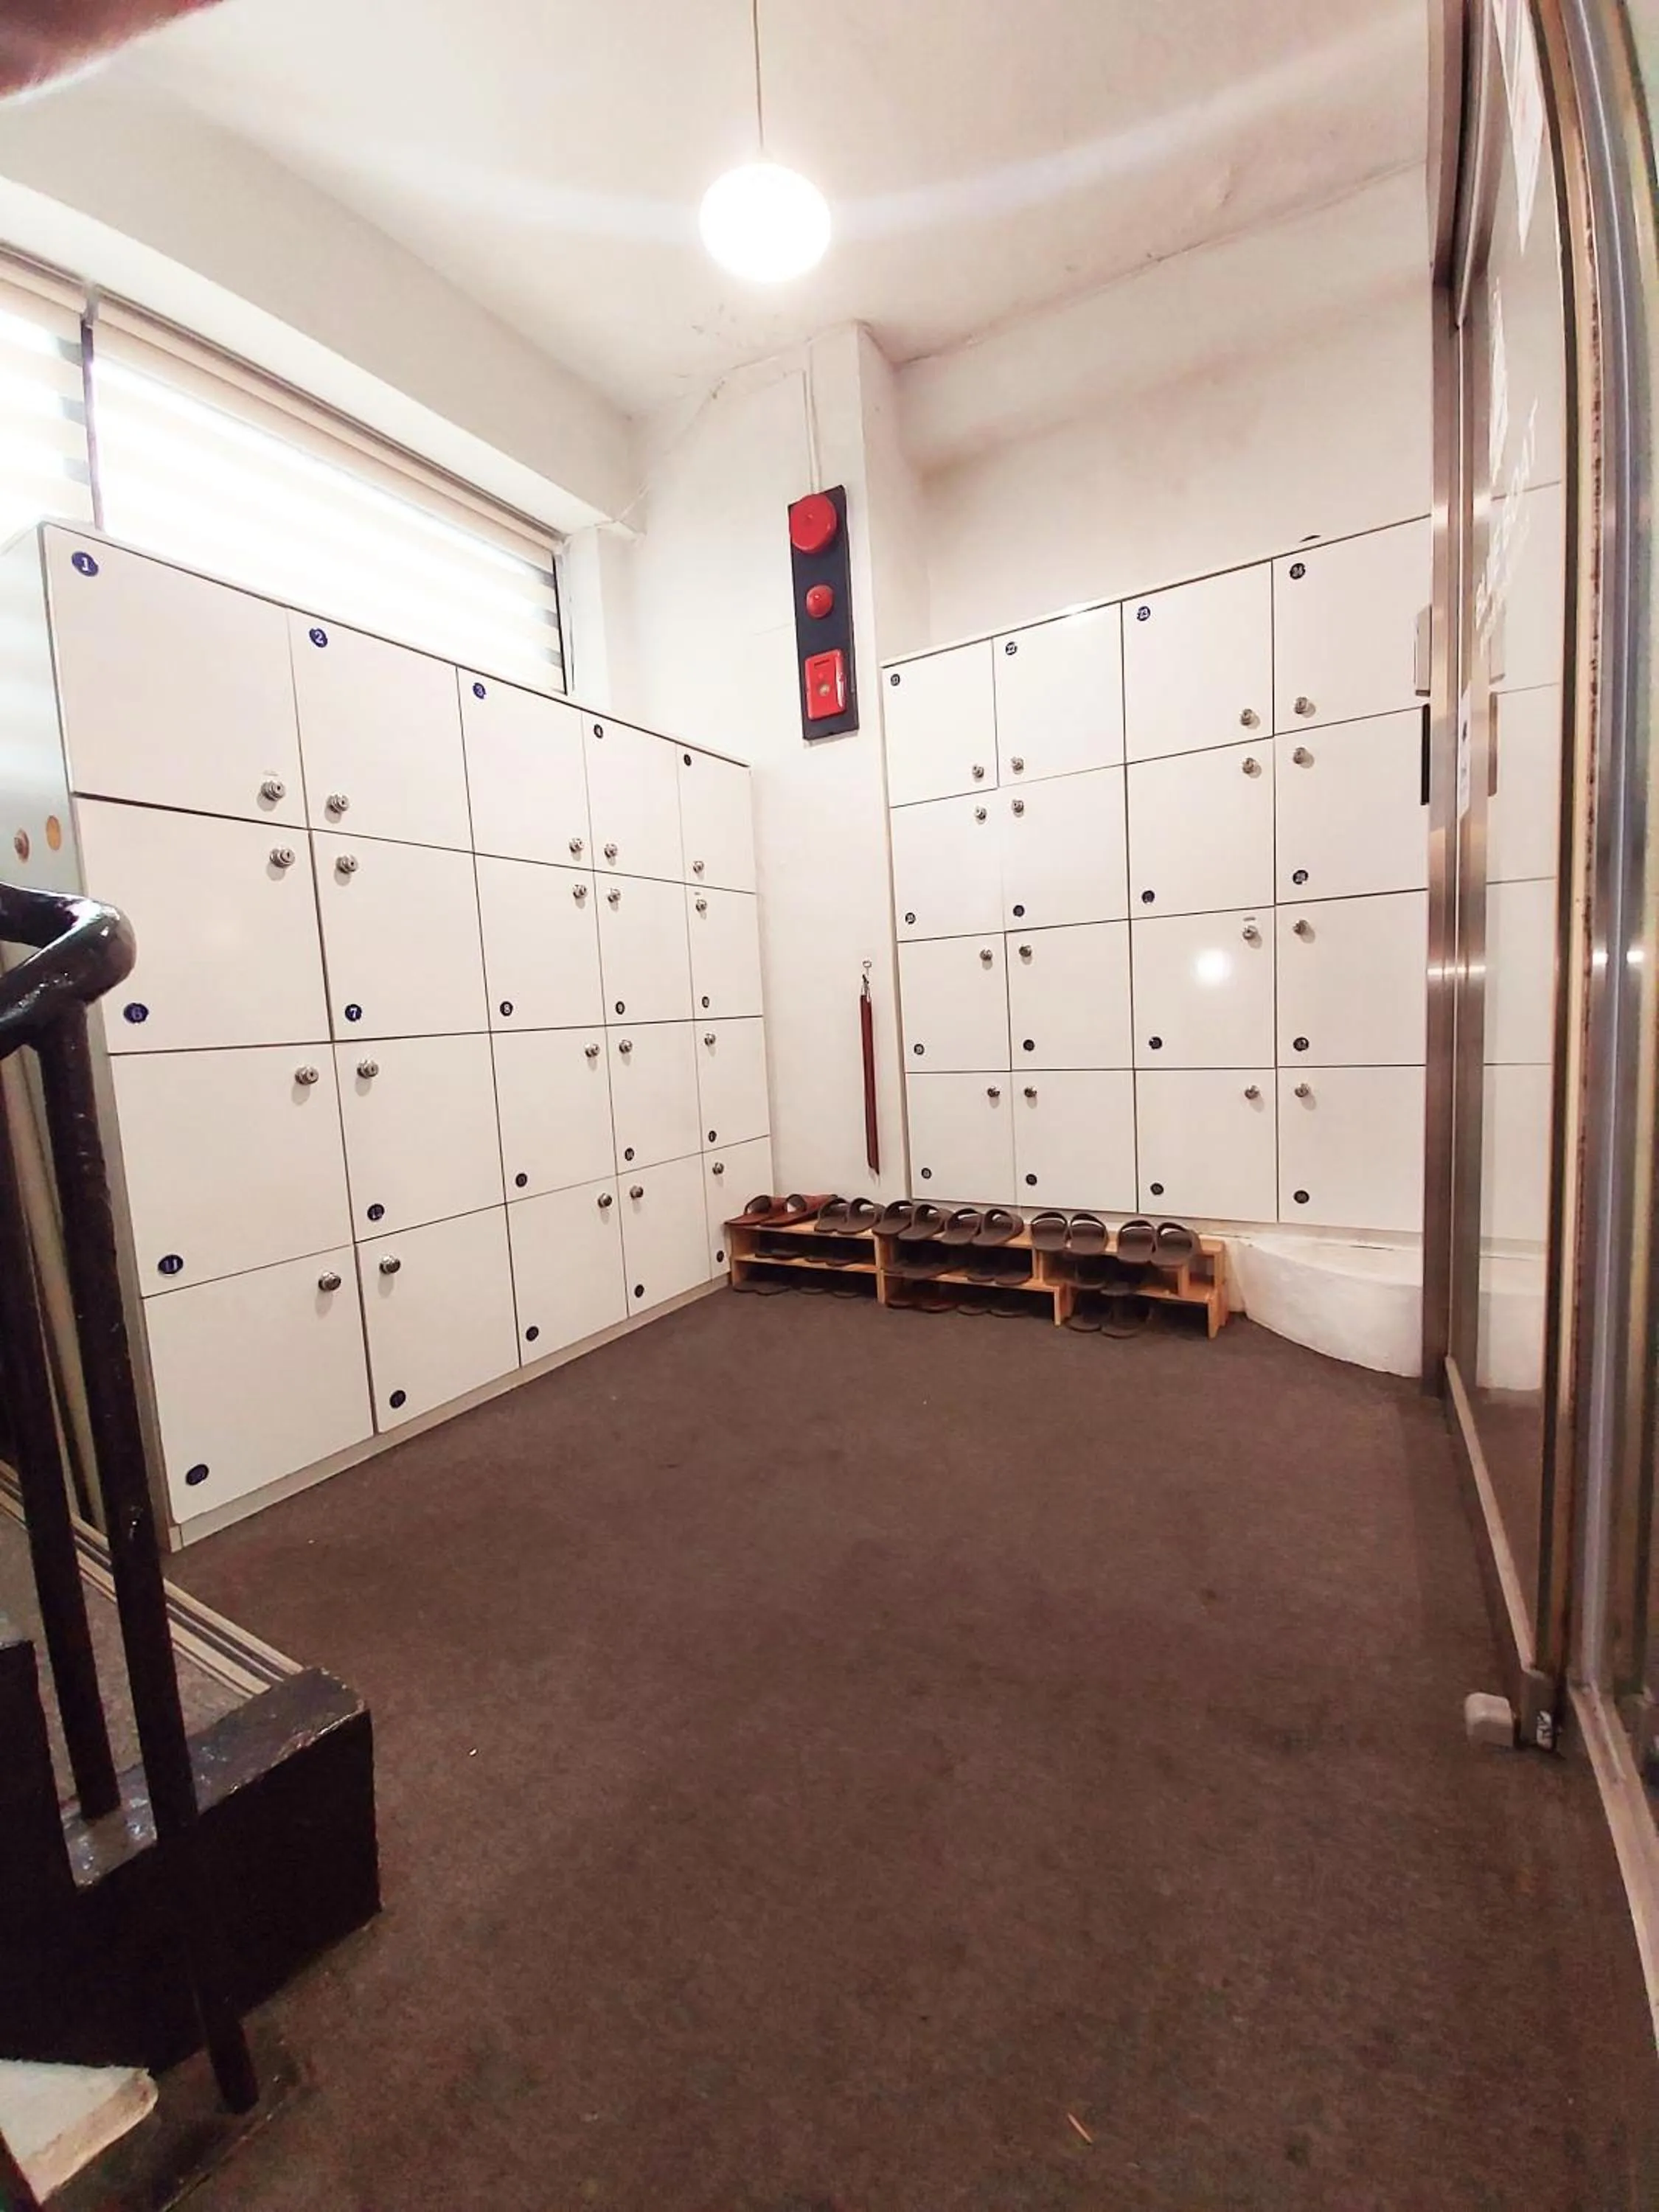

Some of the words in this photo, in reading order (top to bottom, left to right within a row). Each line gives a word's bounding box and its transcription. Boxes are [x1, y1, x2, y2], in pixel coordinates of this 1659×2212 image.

[81, 557, 89, 571] 1
[315, 630, 324, 644] 2
[131, 1007, 142, 1020] 6
[350, 1008, 358, 1018] 7
